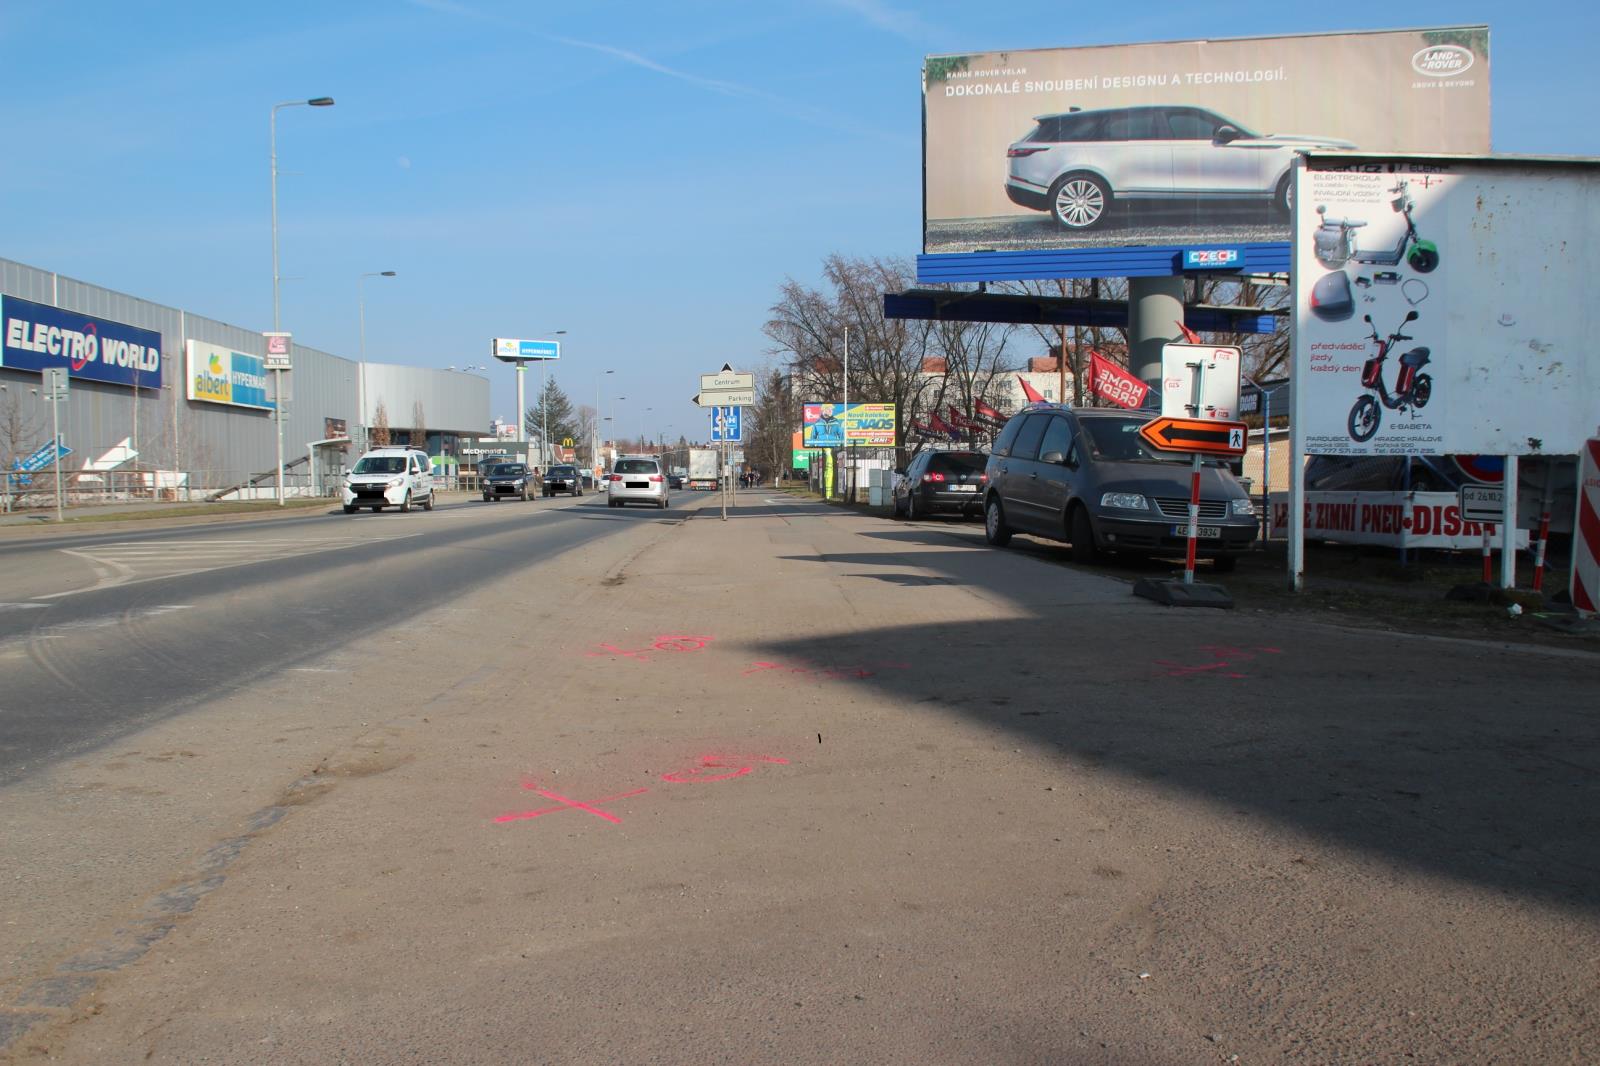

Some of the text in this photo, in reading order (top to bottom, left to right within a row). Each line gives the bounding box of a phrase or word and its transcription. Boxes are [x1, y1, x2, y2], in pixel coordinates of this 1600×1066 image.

[1424, 52, 1453, 61] LAND
[1427, 60, 1463, 69] ROVER
[975, 69, 999, 77] ROVER
[945, 80, 1020, 97] DOKONALÉ
[1024, 75, 1098, 93] SNOUBENÍ
[1102, 74, 1167, 89] DESIGNU
[1171, 74, 1181, 85] A
[1188, 250, 1238, 263] CZECH
[6, 317, 160, 372] ELECTRO WORLD
[196, 369, 229, 395] albert
[1316, 497, 1357, 532] ZIMNÍ
